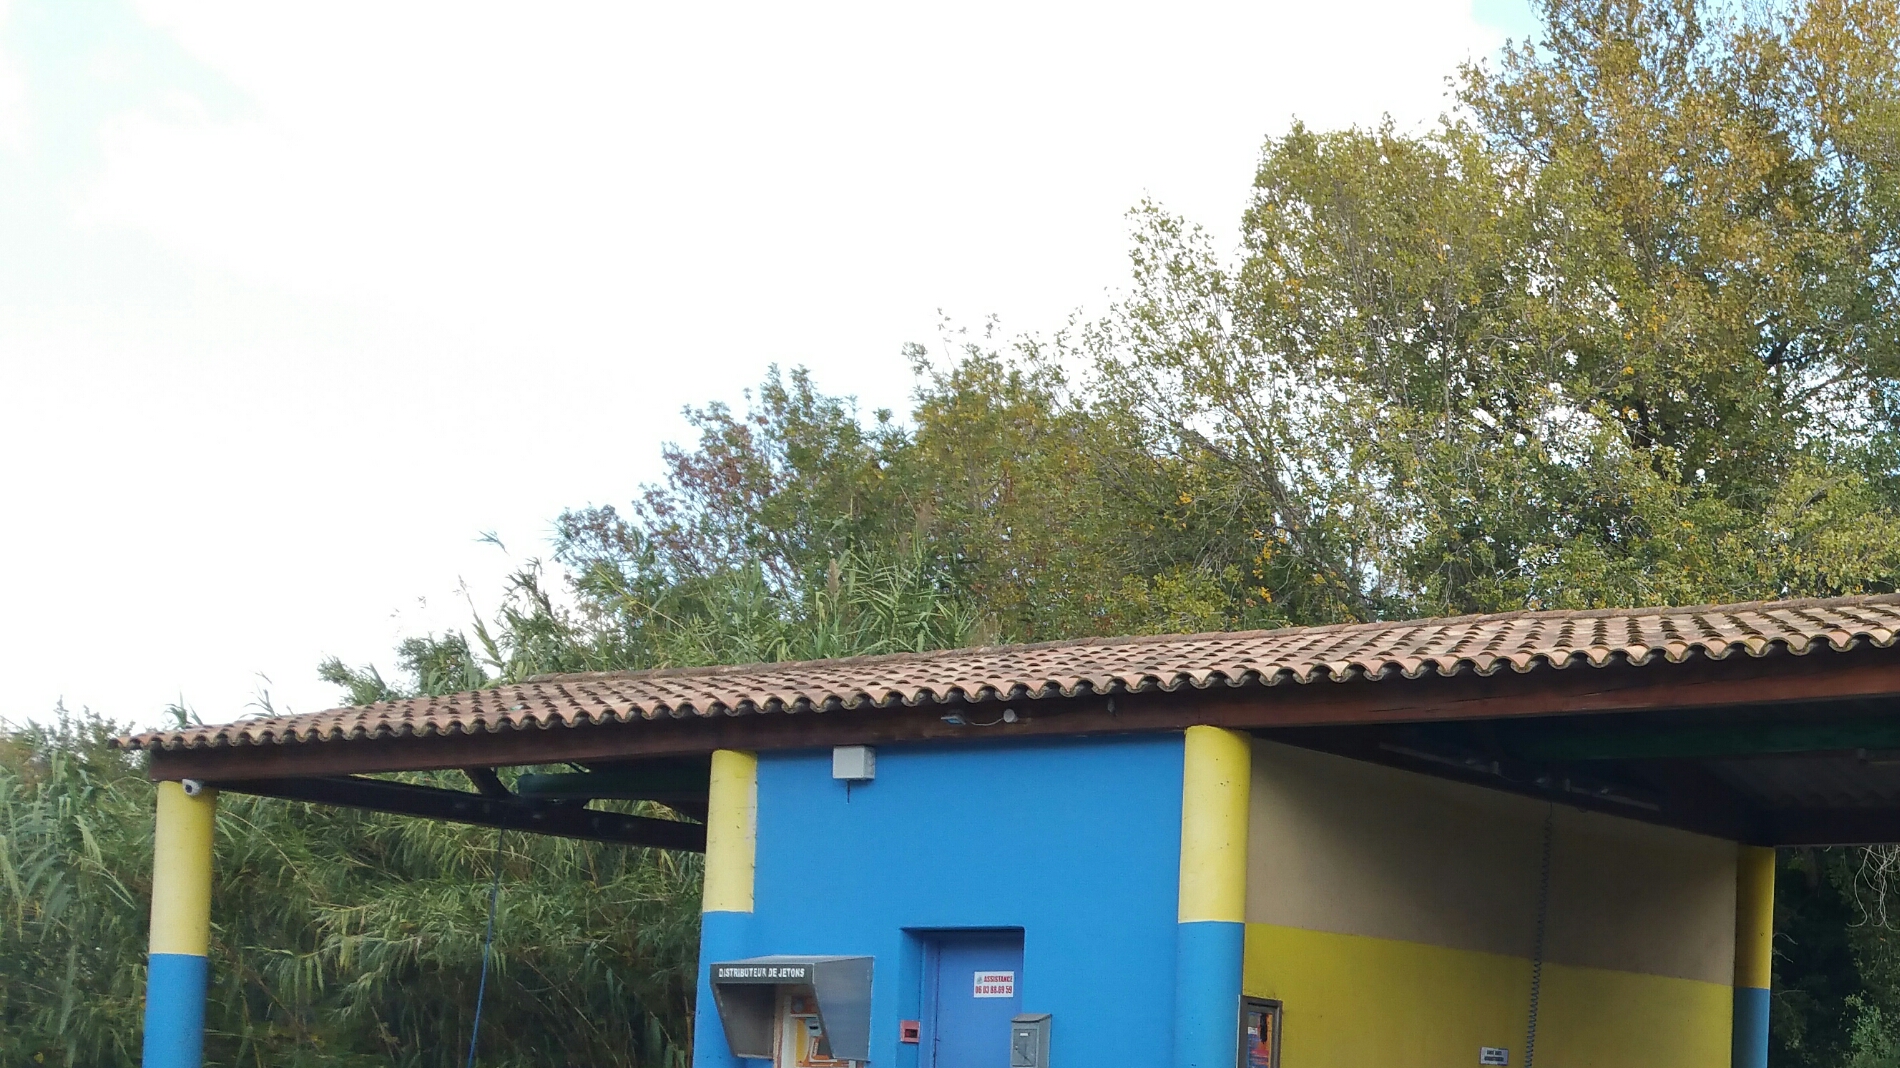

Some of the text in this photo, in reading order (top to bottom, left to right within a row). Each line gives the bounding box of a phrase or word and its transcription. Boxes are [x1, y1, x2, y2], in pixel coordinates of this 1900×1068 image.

[719, 967, 805, 978] DISTRIBUTEUR DE JETONS
